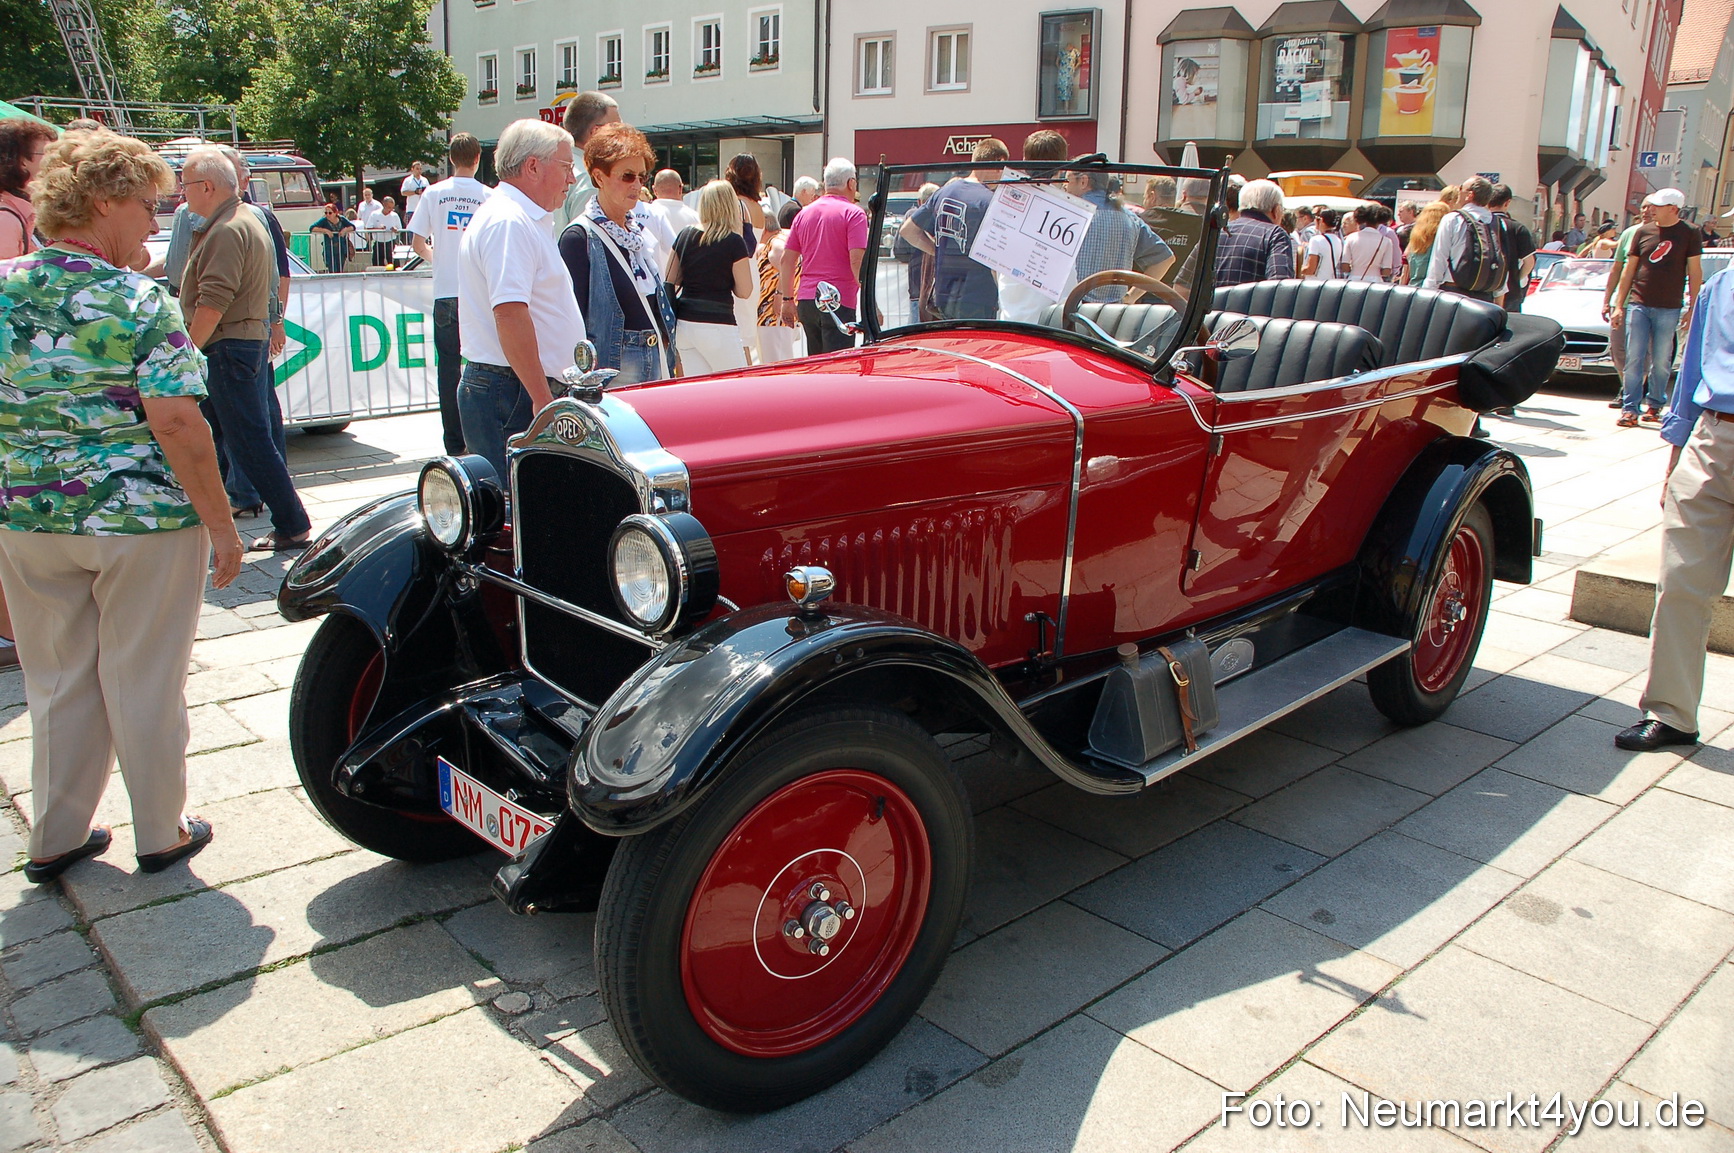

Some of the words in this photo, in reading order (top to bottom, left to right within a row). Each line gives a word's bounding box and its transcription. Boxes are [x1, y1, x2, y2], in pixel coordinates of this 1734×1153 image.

[439, 196, 482, 206] AZUBI-PROJEK
[1036, 210, 1079, 247] 166
[349, 313, 440, 372] DE
[556, 418, 579, 439] OPEL
[443, 791, 450, 803] D
[453, 775, 484, 830] NM
